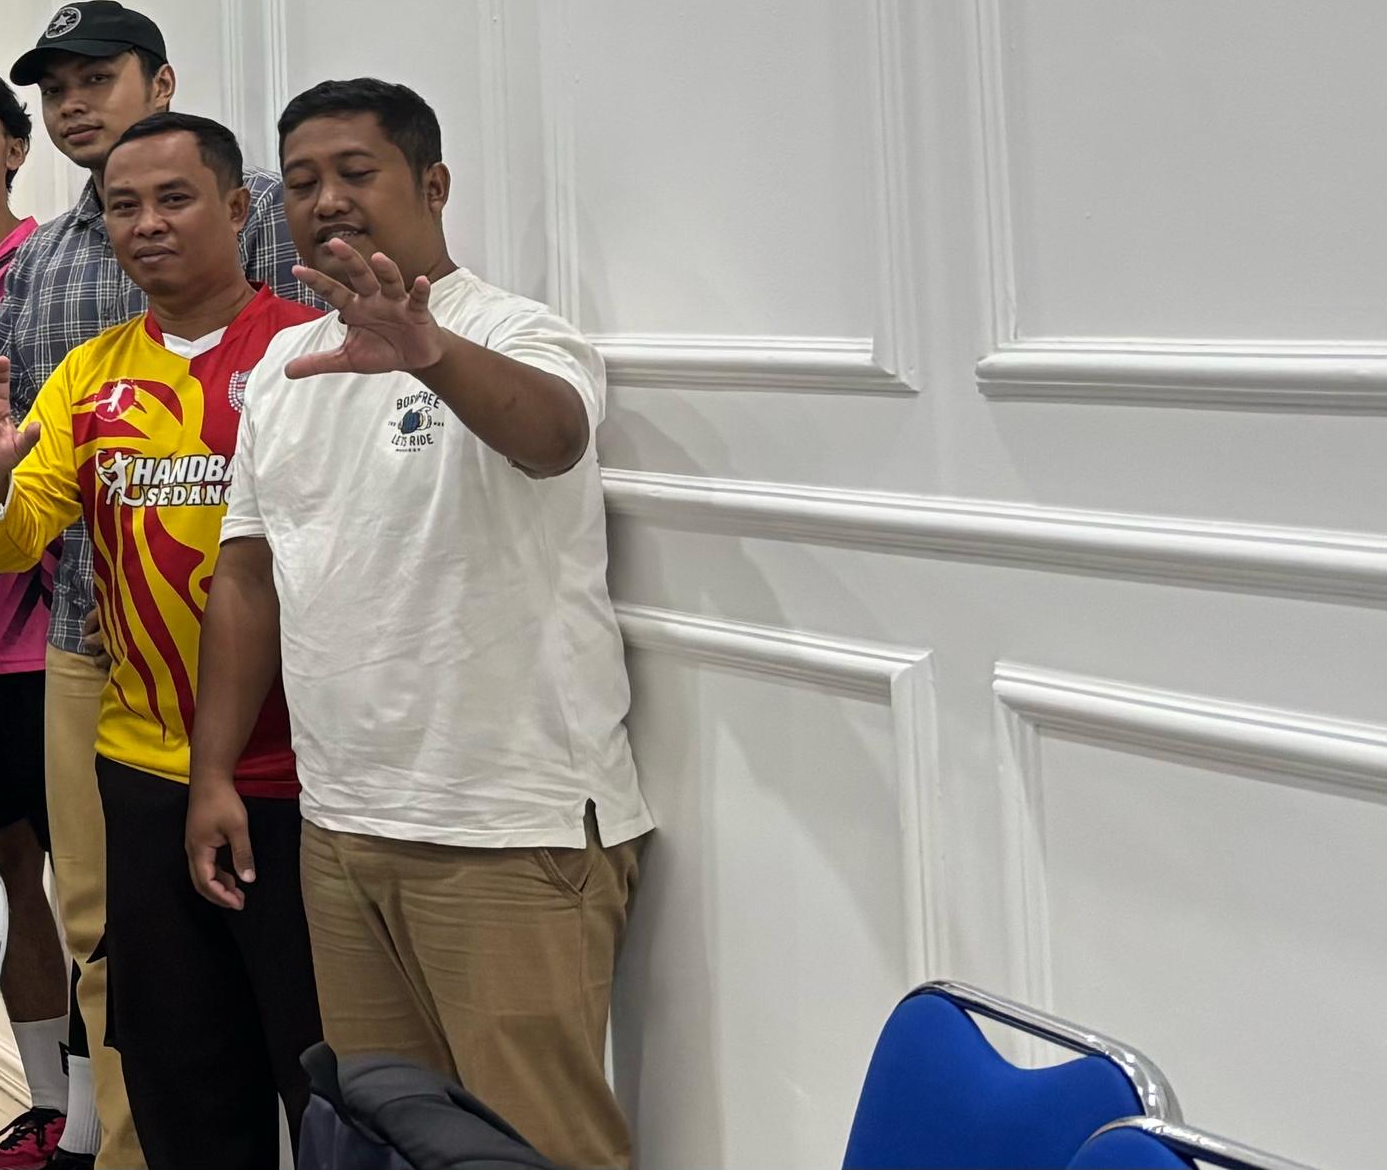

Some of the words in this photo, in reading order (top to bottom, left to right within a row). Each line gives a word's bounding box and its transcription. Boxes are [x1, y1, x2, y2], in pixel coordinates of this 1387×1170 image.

[417, 390, 443, 409] FREE
[409, 433, 434, 447] RIDE
[145, 485, 231, 507] SEDAN
